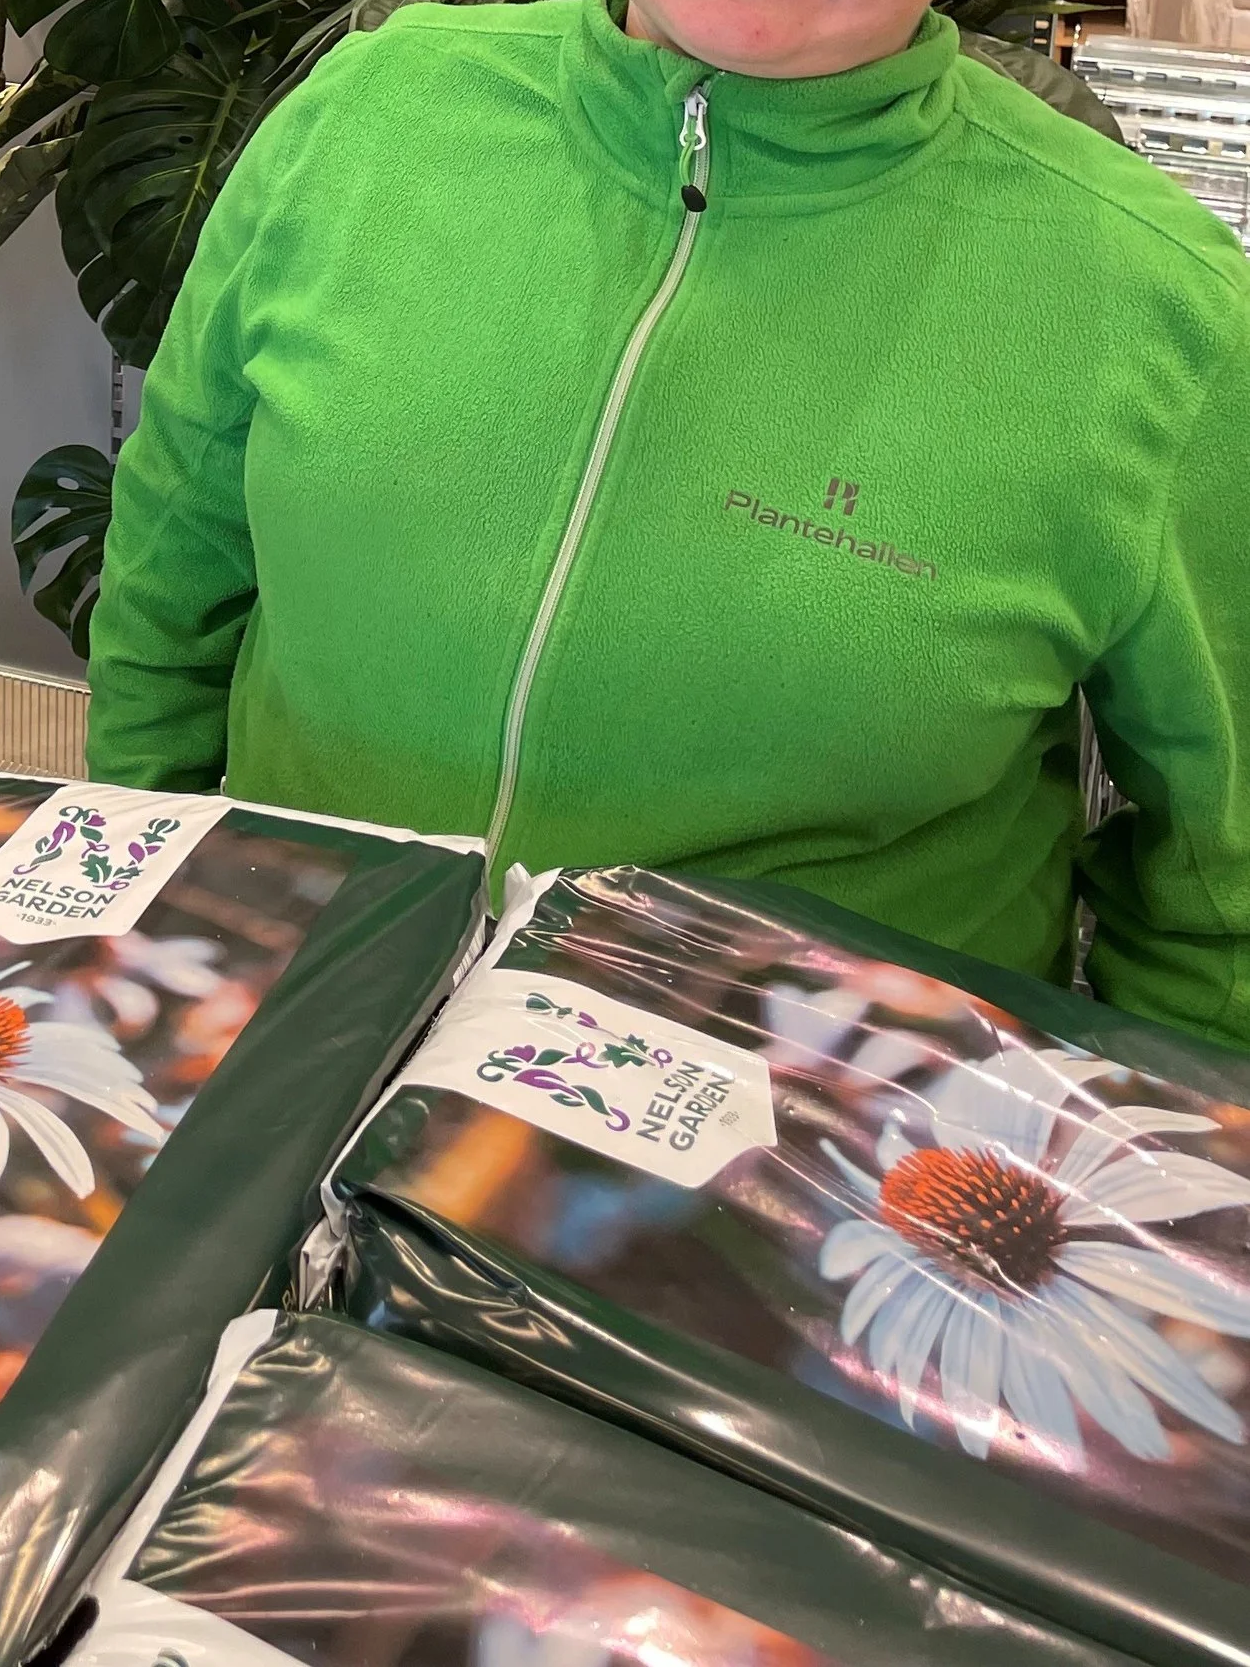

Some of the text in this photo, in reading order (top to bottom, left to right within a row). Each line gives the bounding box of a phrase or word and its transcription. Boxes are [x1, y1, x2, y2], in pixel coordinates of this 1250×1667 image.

[723, 489, 938, 581] Plantehallen
[1, 877, 117, 905] NELSON
[636, 1060, 706, 1143] NELSON
[668, 1071, 734, 1152] GARDEN
